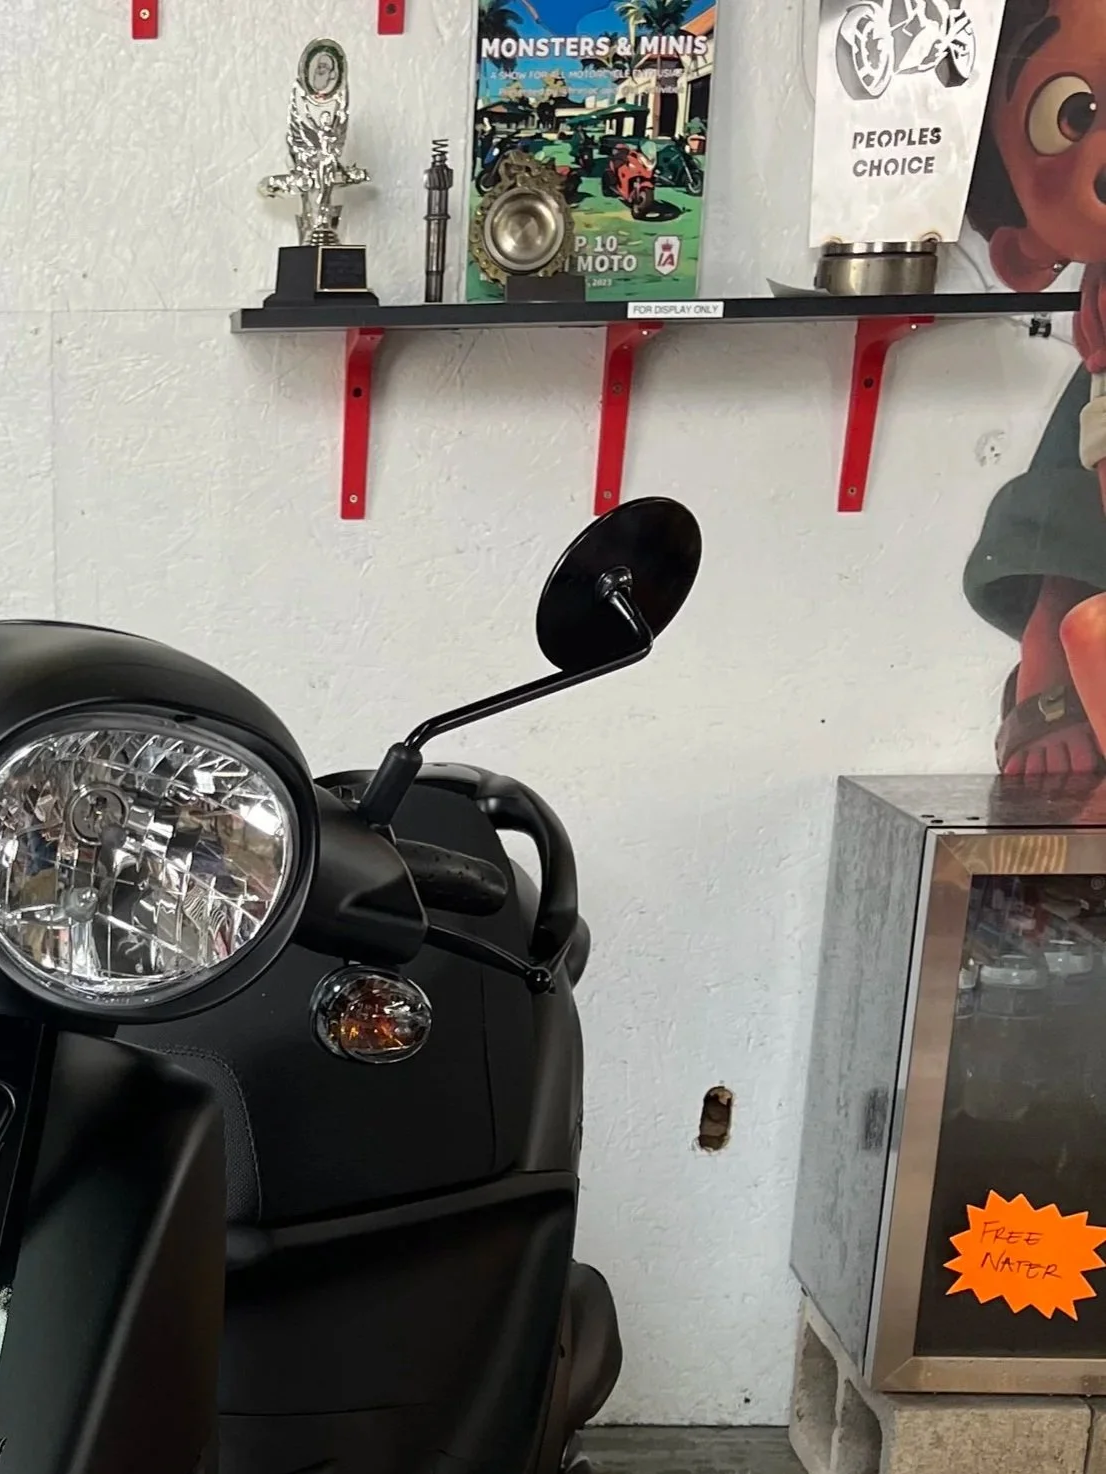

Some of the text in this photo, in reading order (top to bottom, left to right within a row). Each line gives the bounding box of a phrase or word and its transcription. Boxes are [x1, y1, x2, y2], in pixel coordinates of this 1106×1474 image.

[481, 36, 708, 58] MONSTERS & MINIS
[852, 127, 942, 149] PEOPLES
[852, 156, 935, 177] CHOICE
[595, 235, 617, 252] 10
[577, 254, 637, 273] MOTO
[633, 304, 718, 314] FOR DISPLAY ONLY
[980, 1220, 1043, 1246] FREE
